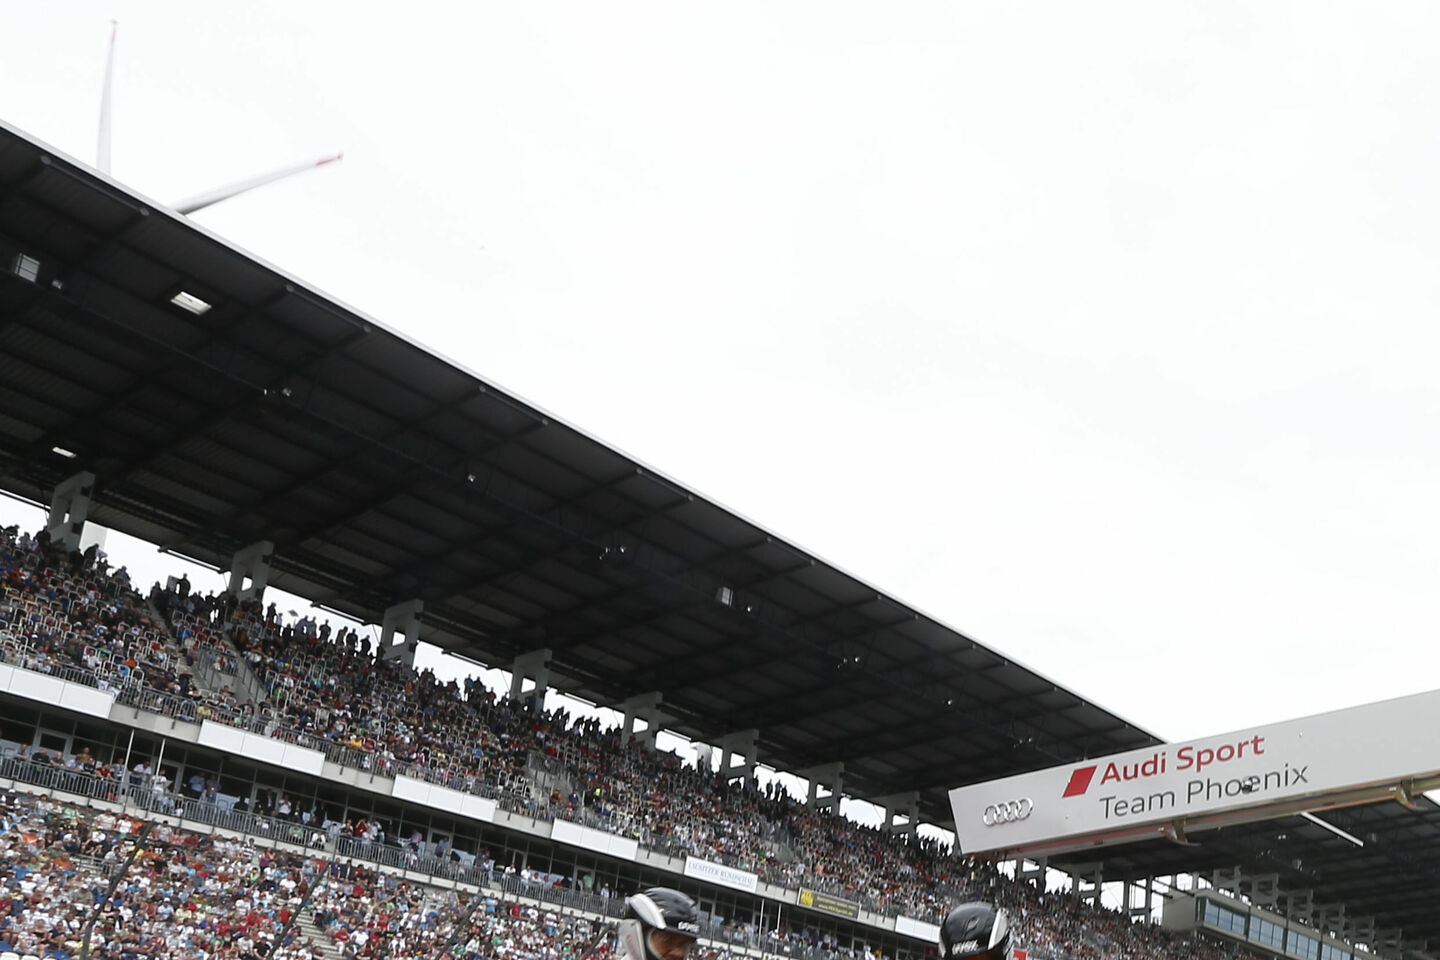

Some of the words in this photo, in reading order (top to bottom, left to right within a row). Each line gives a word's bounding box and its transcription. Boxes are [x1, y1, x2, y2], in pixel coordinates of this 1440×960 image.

[1100, 752, 1167, 785] Audi
[1176, 735, 1266, 772] Sport
[1099, 787, 1176, 820] Team
[1187, 762, 1309, 805] Phoenix
